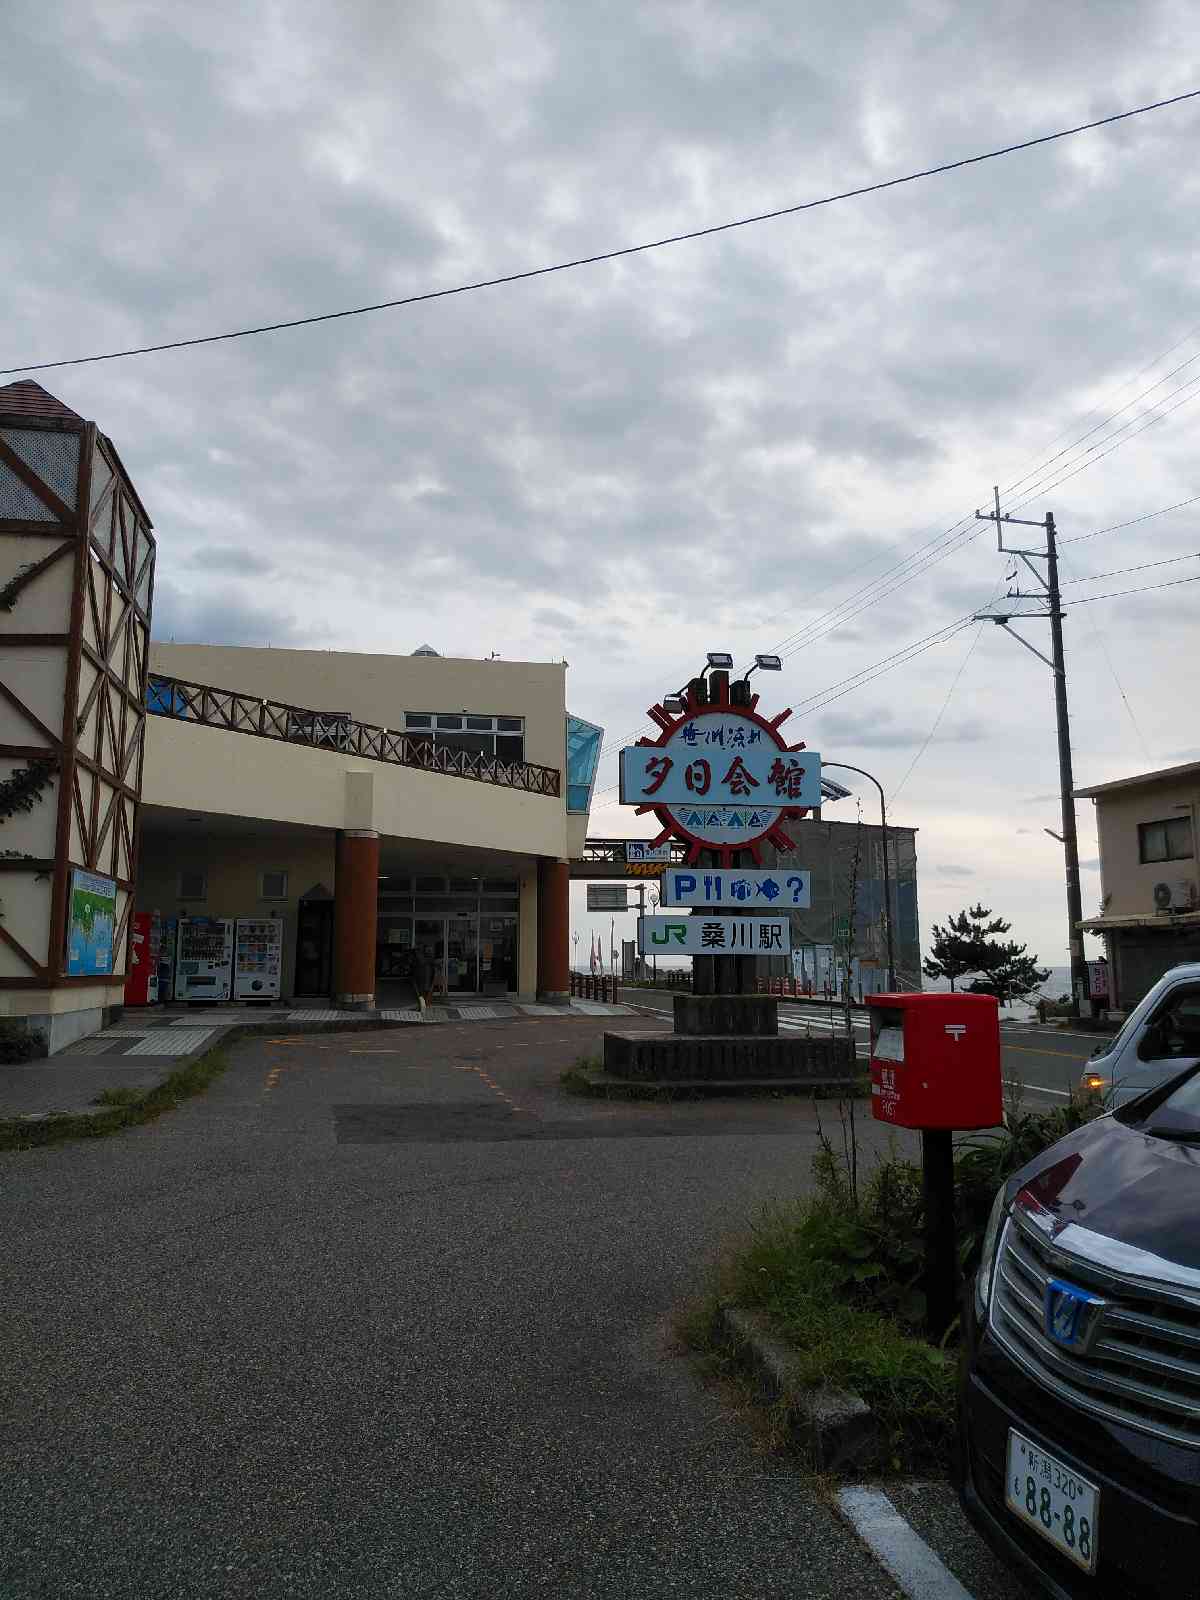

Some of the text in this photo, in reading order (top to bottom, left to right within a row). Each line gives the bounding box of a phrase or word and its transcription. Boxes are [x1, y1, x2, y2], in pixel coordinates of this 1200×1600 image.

[642, 756, 806, 799] 夕日会館
[675, 876, 696, 900] P
[652, 922, 782, 949] JR 桑川駅
